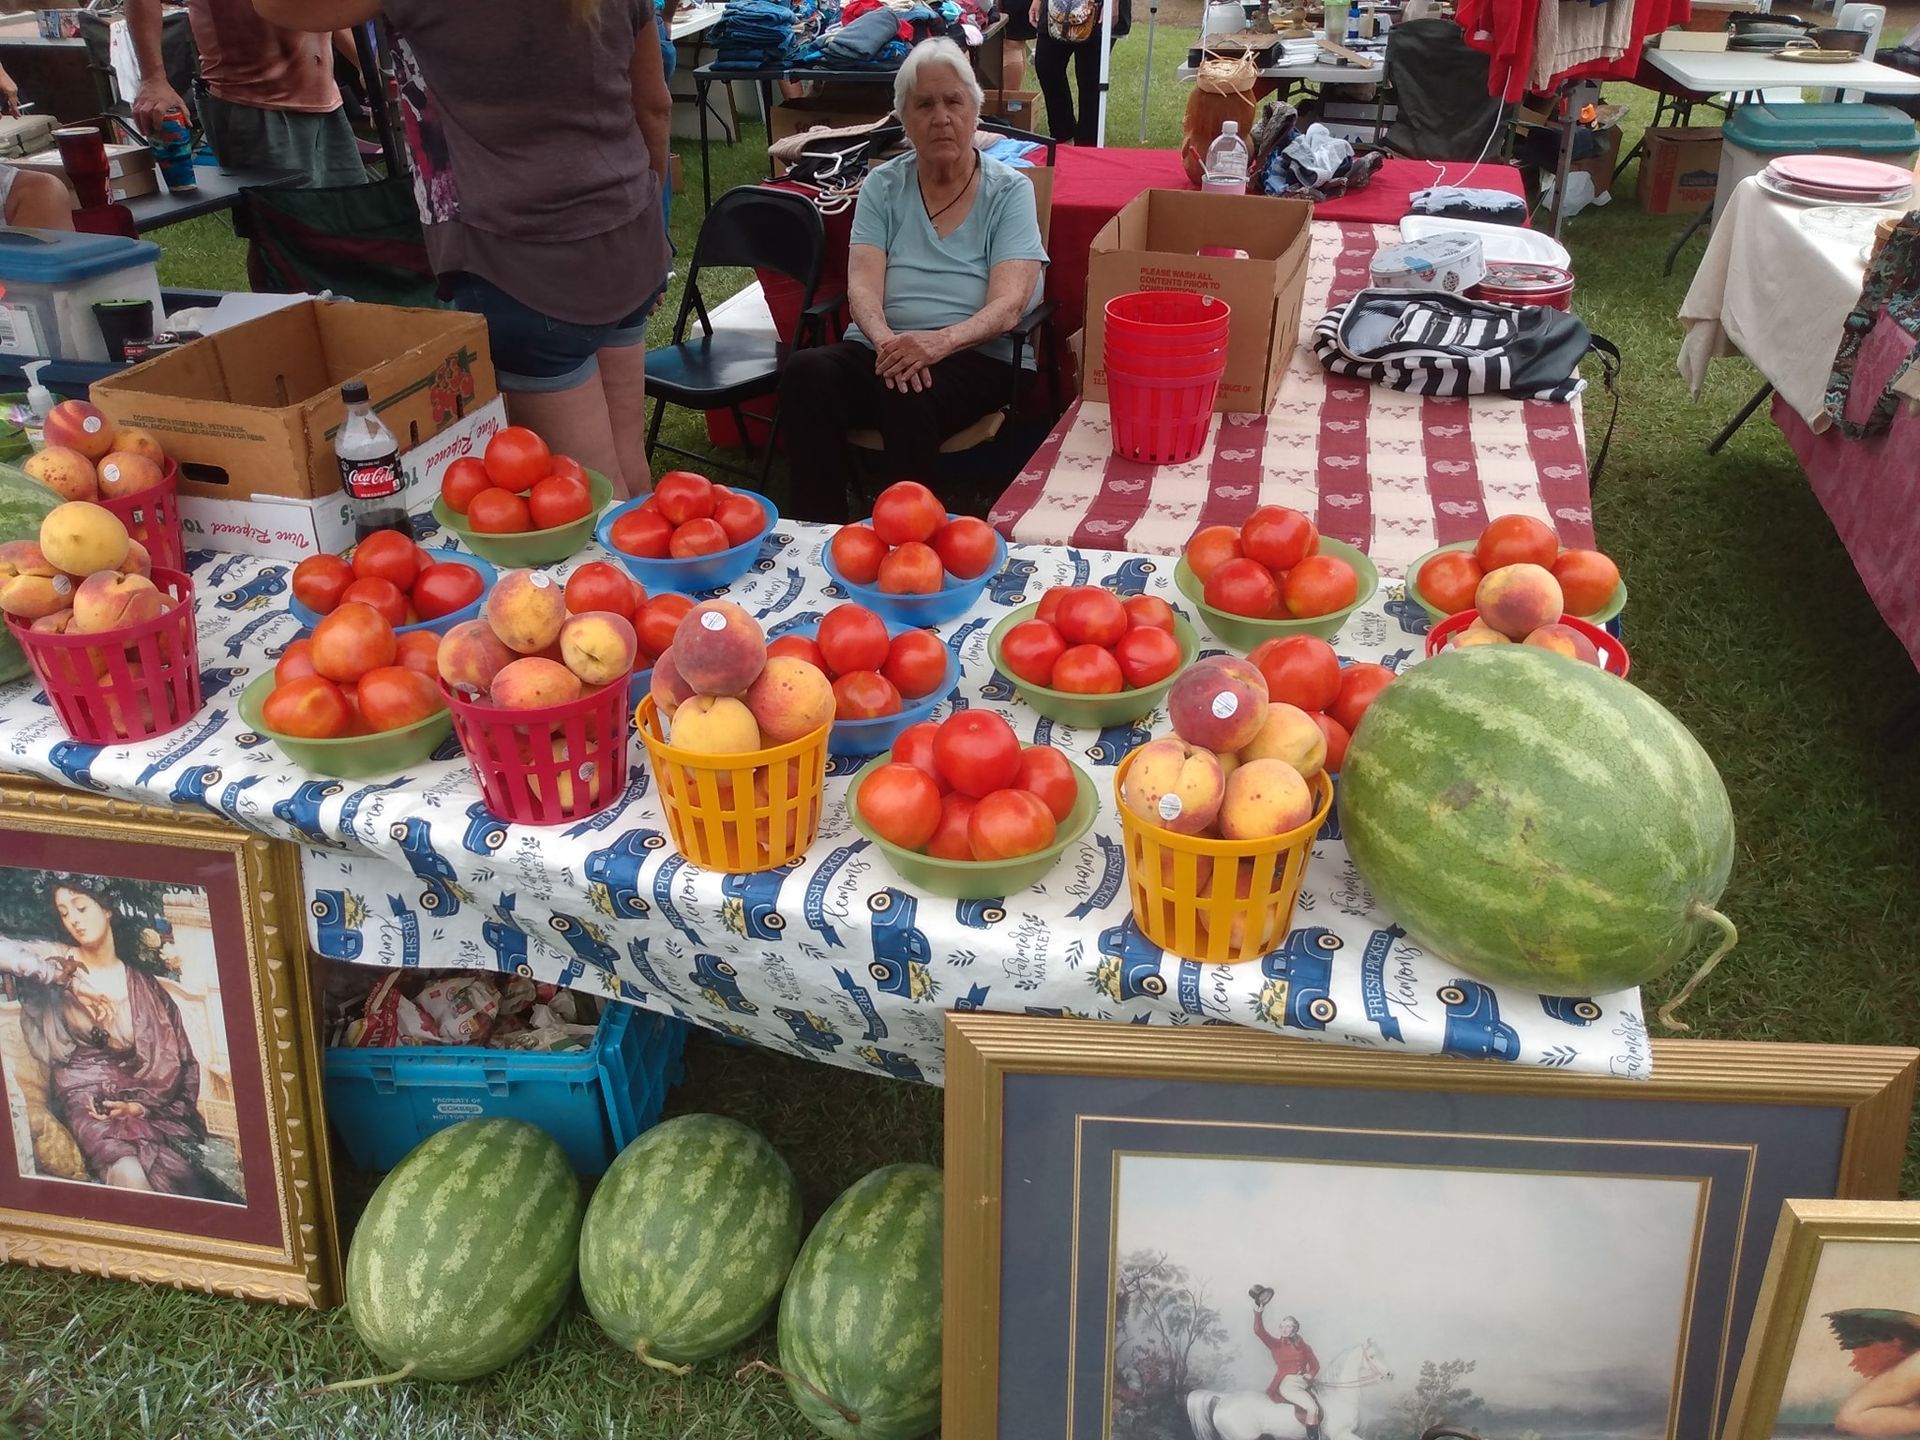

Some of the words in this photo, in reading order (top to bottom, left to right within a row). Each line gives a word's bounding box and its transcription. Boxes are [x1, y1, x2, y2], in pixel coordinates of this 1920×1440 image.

[1140, 267, 1171, 277] PLEASE
[1172, 270, 1196, 280] WASH
[1198, 272, 1213, 280] ALL
[1140, 276, 1182, 286] CONTENTS
[1184, 280, 1208, 288] PRIOR
[1210, 282, 1220, 290] TO
[476, 416, 500, 438] Vine
[425, 435, 473, 476] Ripened
[349, 464, 394, 486] Coca-Cola
[211, 521, 272, 544] Ripened
[275, 530, 310, 549] Vine
[1065, 842, 1107, 899] lemons
[1108, 846, 1122, 877] FRESH
[807, 885, 824, 928] FRESH
[816, 848, 850, 882] PICKED
[822, 858, 872, 929] lemons
[1091, 875, 1119, 908] PICKED
[657, 900, 684, 930] FRESH
[403, 913, 418, 957] FRESH
[1365, 932, 1390, 970] PICKED
[1034, 930, 1052, 981] MARKET
[1183, 971, 1199, 1016] FRESH
[1366, 971, 1385, 1018] FRESH
[1385, 942, 1428, 1022] lemons
